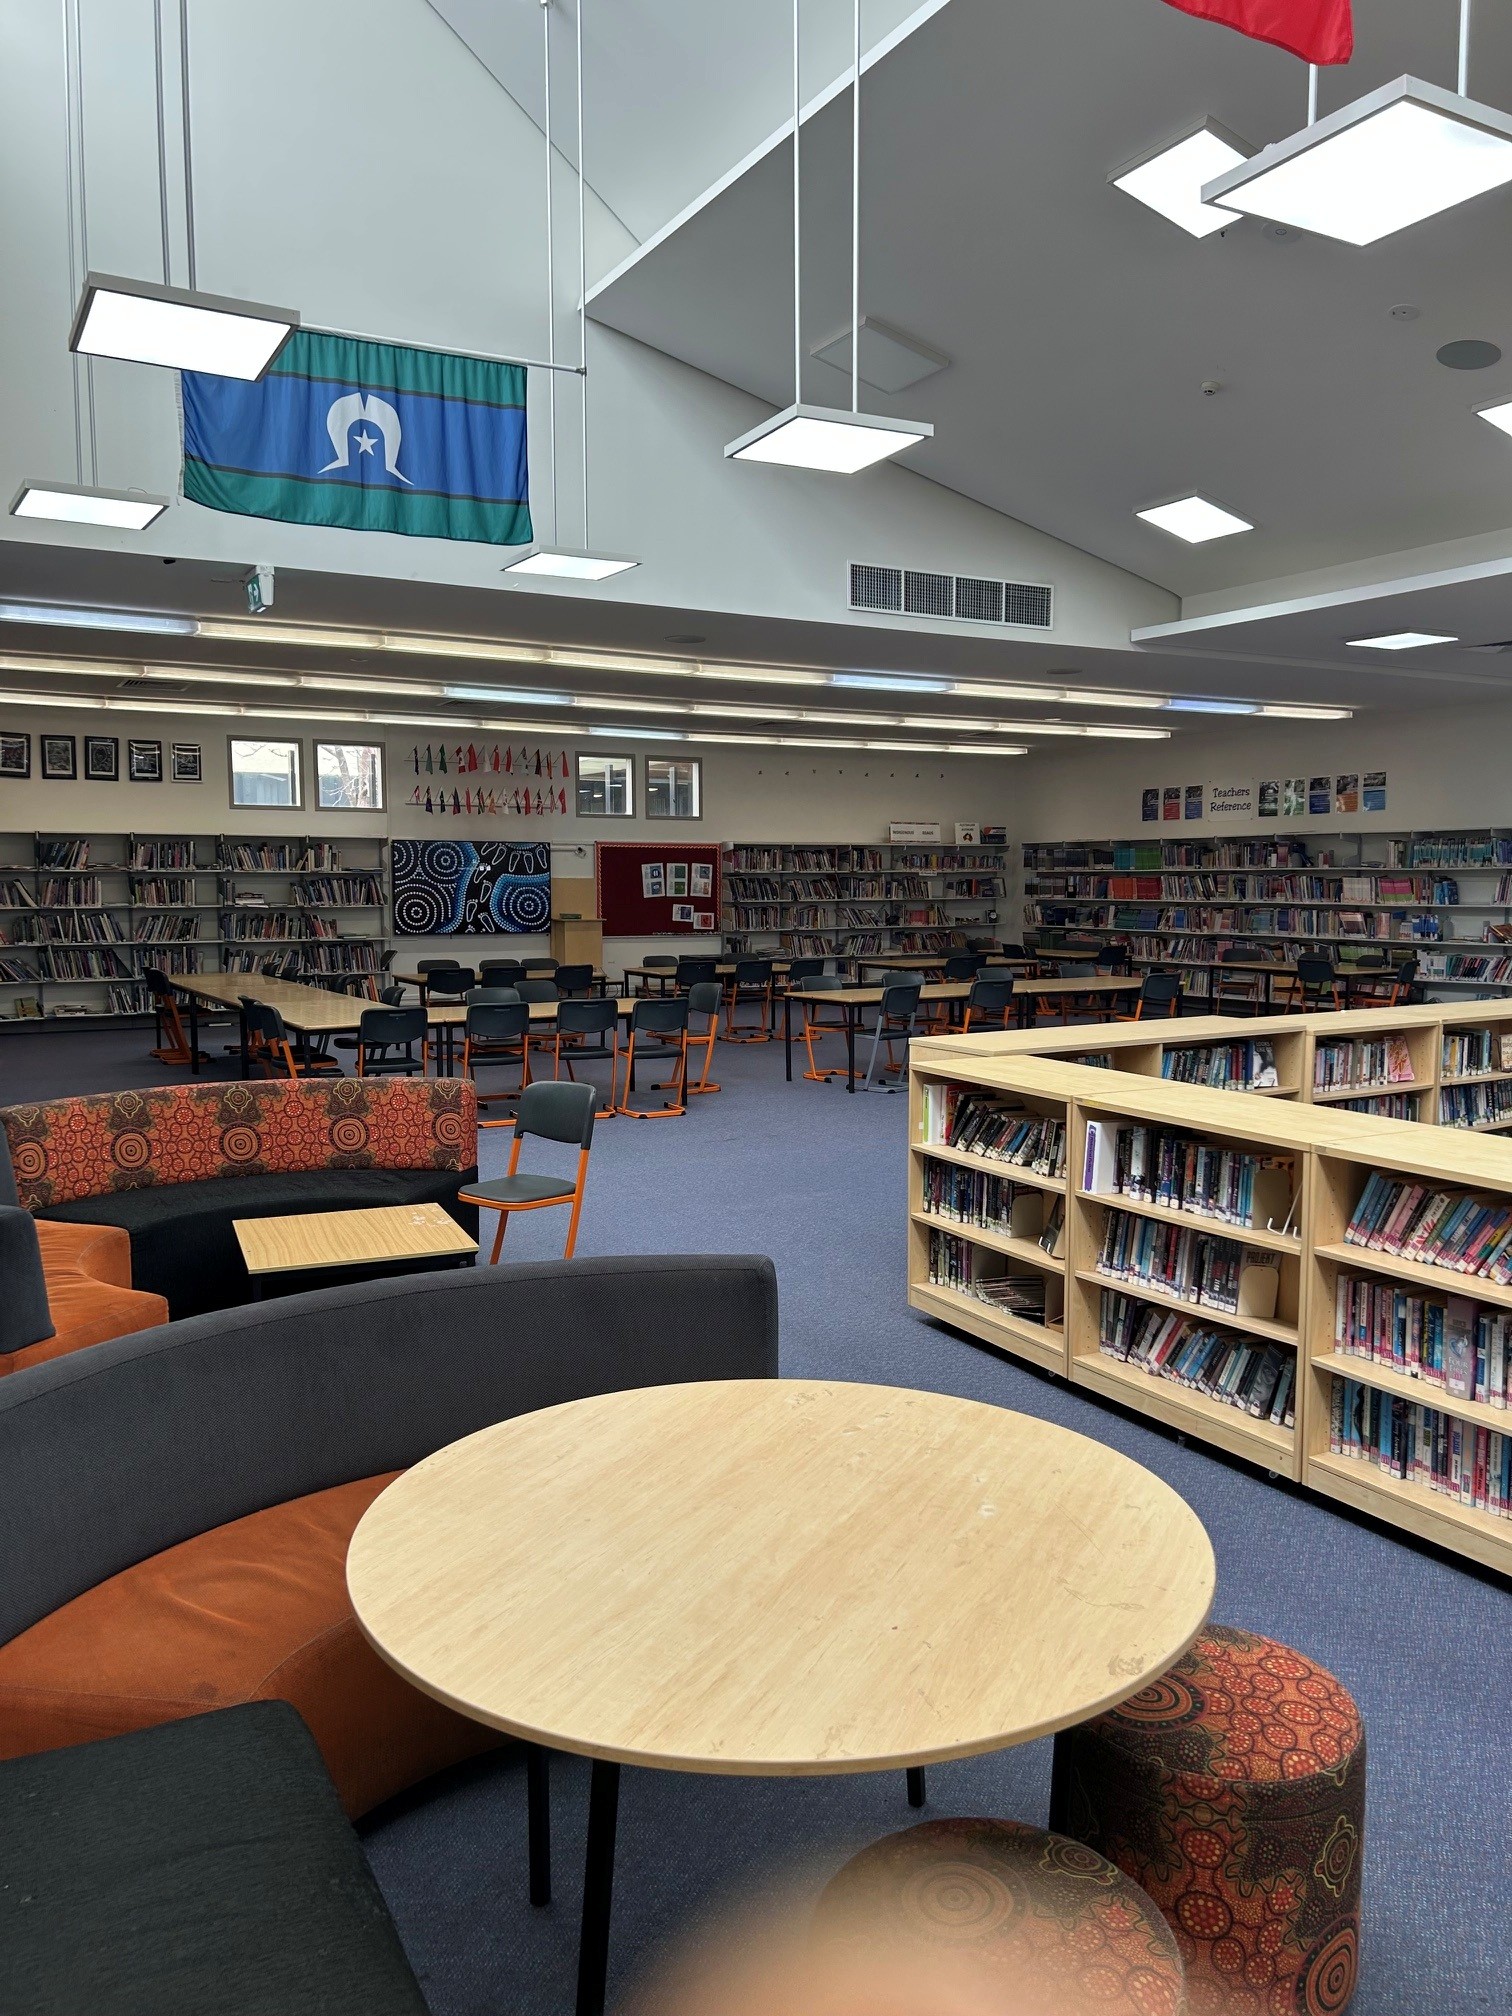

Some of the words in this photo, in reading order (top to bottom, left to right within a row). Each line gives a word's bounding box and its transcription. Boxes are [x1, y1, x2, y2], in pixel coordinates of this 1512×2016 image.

[1212, 787, 1251, 798] Teachers
[1210, 801, 1252, 812] Reference
[1448, 1356, 1468, 1368] FOUR
